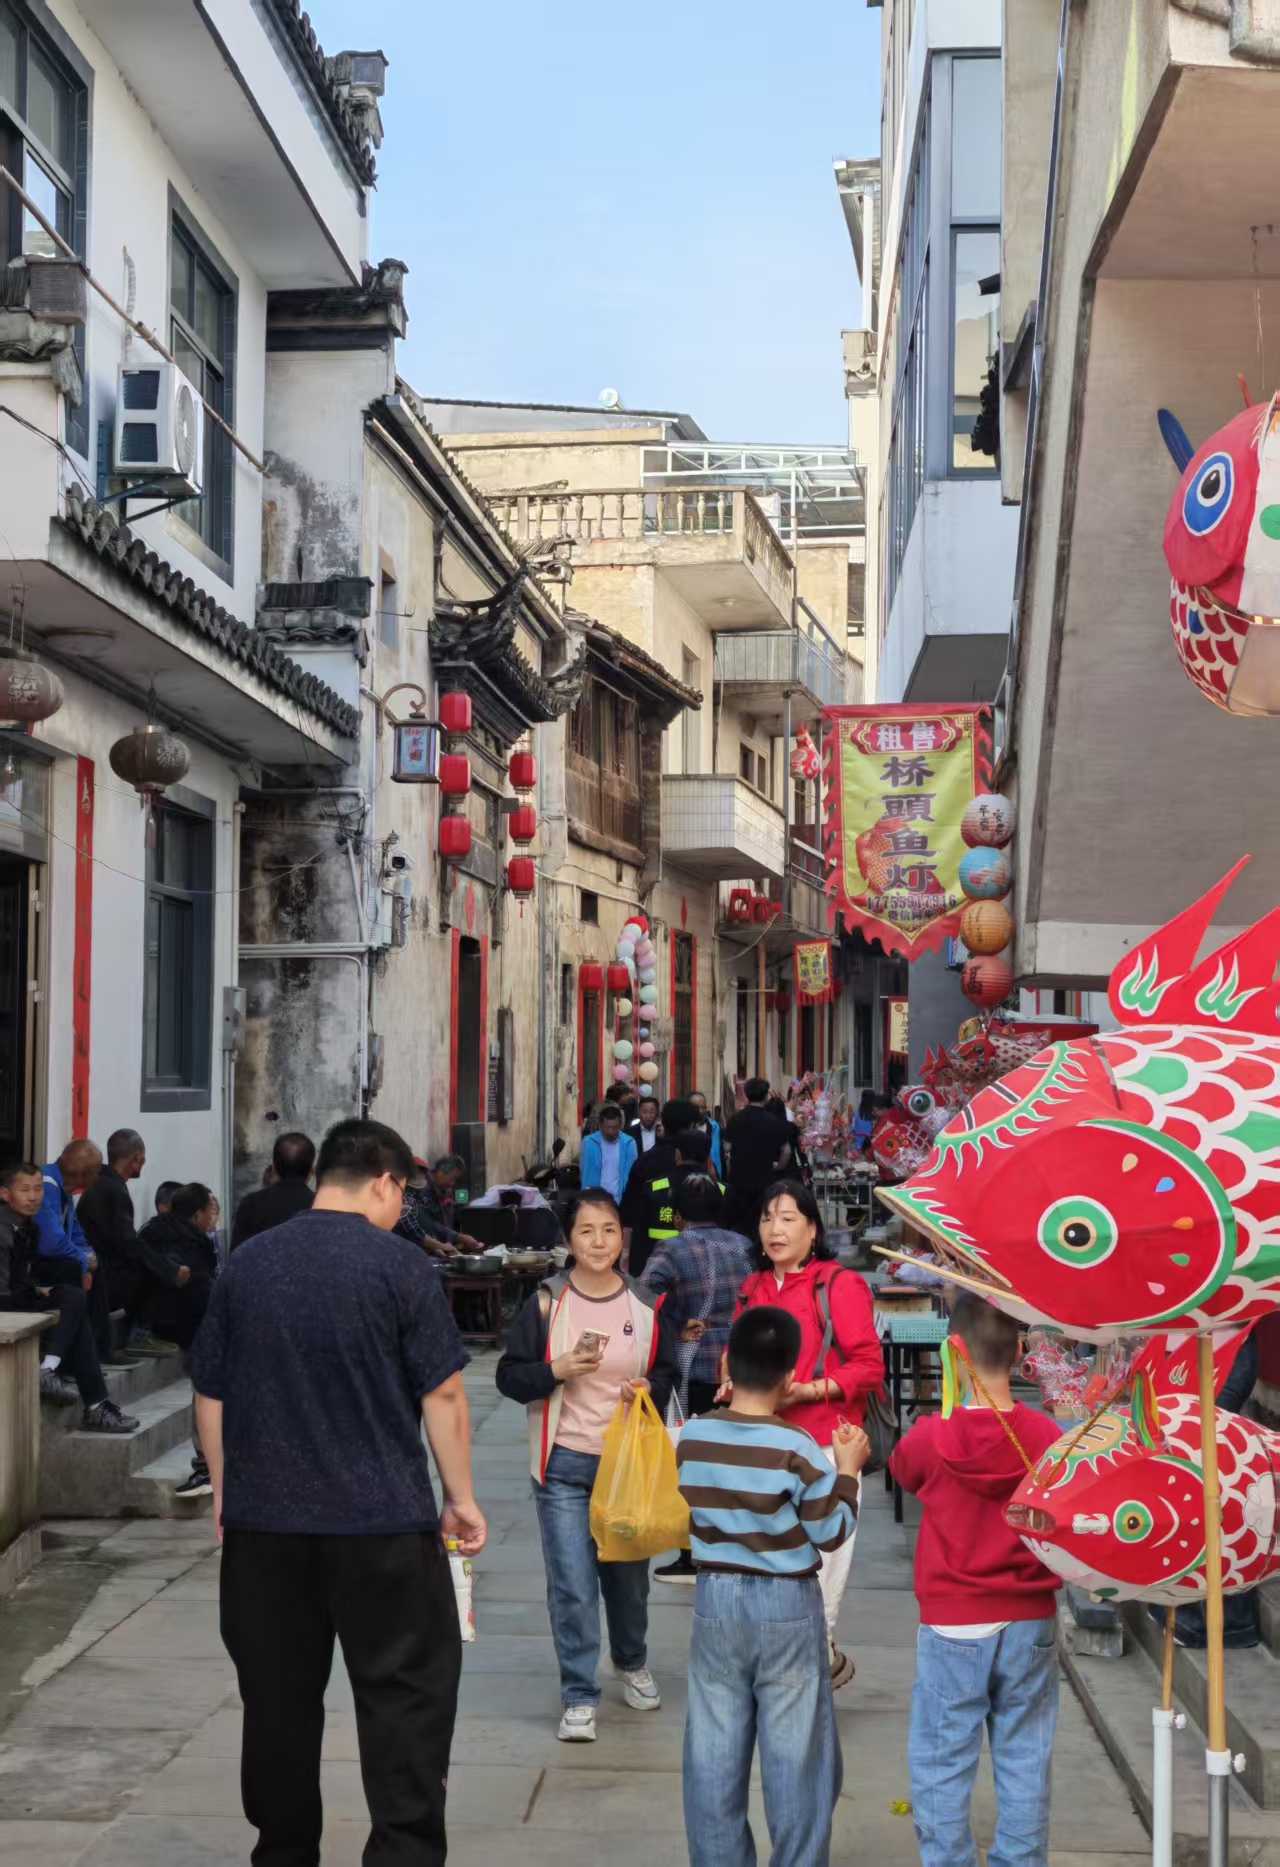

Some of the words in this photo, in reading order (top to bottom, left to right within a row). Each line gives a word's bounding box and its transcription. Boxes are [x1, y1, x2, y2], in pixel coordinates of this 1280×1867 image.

[876, 722, 937, 751] 租售
[880, 756, 937, 894] 桥頭鱼灯
